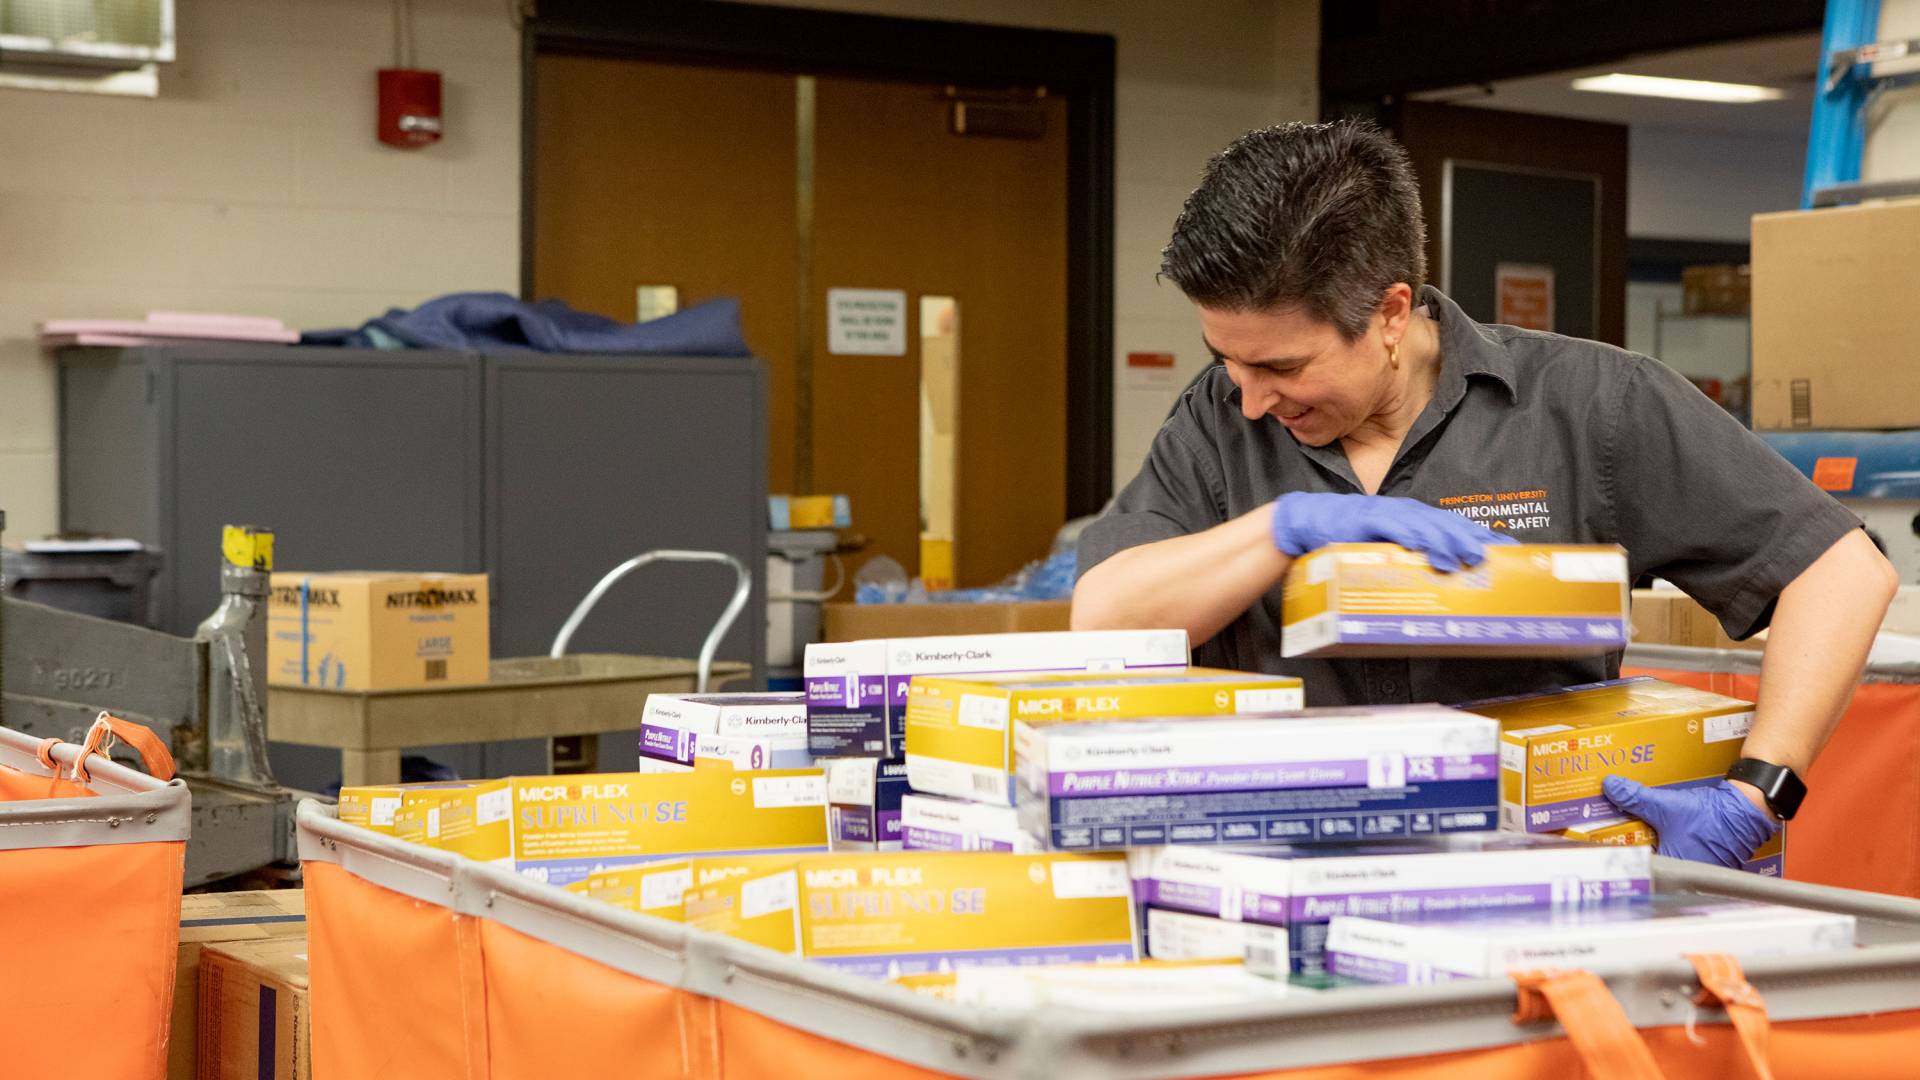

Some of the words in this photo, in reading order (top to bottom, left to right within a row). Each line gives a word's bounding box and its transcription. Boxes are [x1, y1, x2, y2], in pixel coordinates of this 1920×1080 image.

[1440, 494, 1493, 505] PRINCETON
[1497, 490, 1547, 501] UNIVERSITY
[1509, 516, 1550, 529] SAFETY
[916, 651, 991, 662] Kimberly-Clark
[1018, 696, 1120, 714] MICROFLEX
[1533, 735, 1613, 756] MICROFLEX
[1407, 757, 1434, 778] XS
[1534, 748, 1626, 776] SUPRENO
[1630, 744, 1655, 764] SE
[519, 784, 629, 802] MICROFLEX
[521, 802, 651, 829] SUPRENO
[655, 800, 688, 823] SE
[1531, 810, 1550, 826] 100
